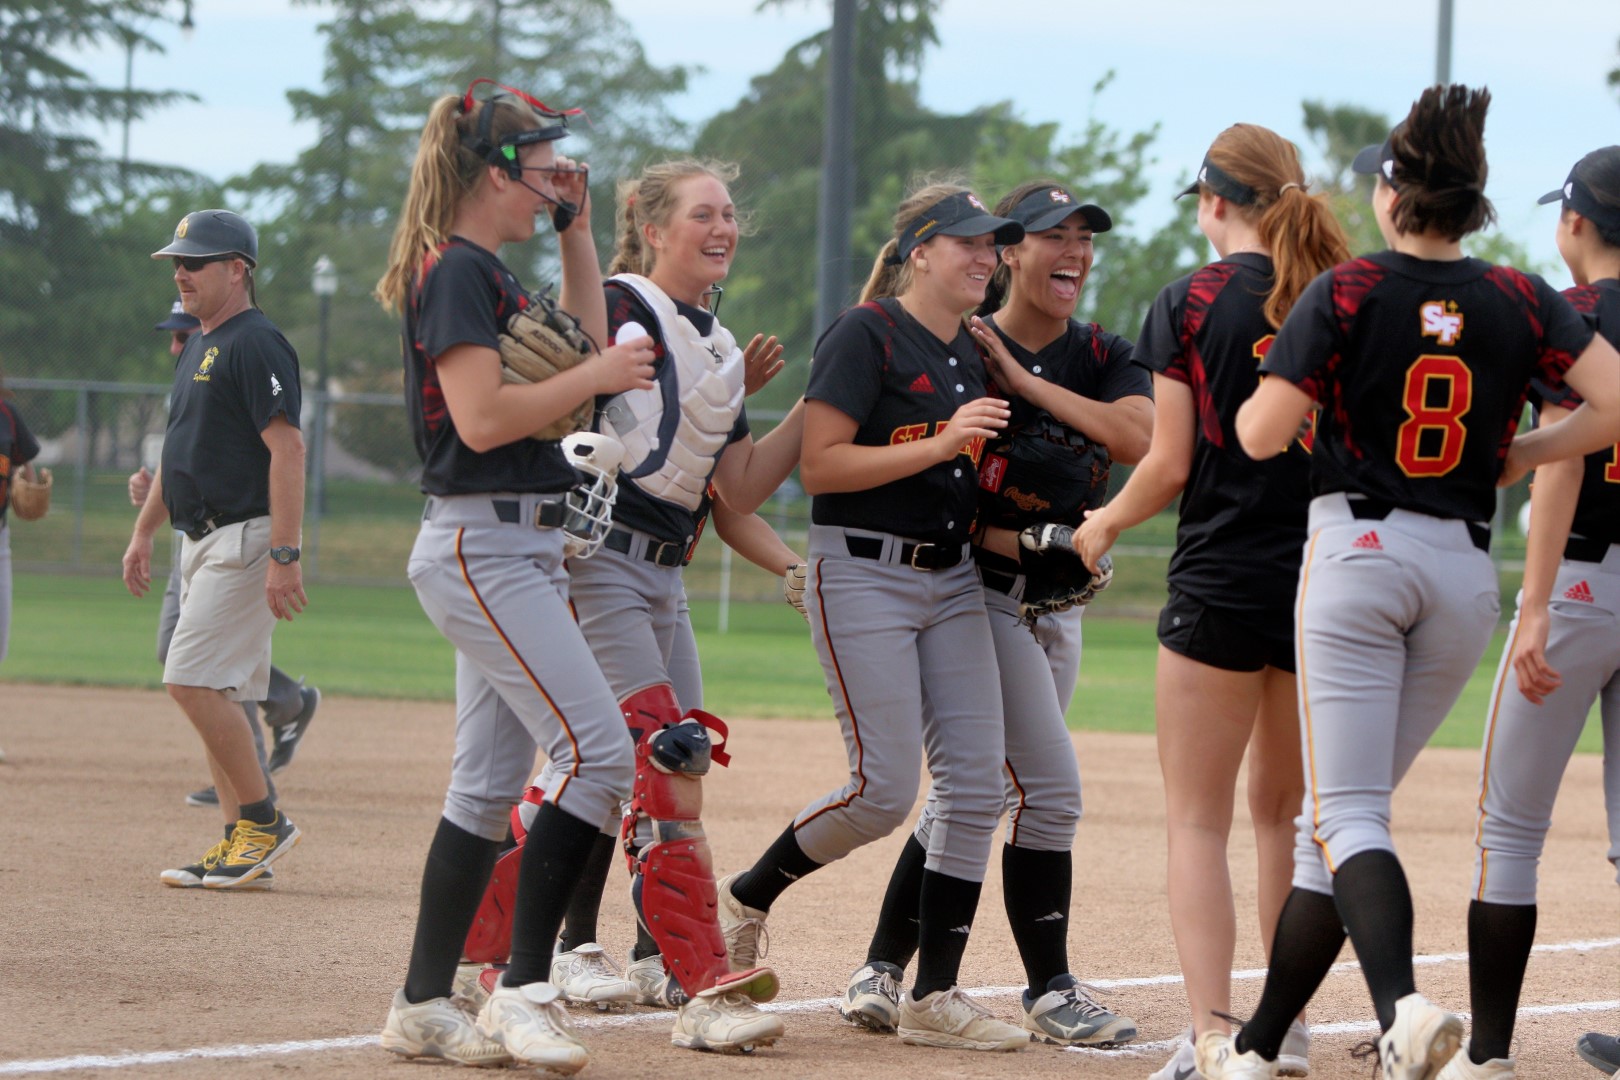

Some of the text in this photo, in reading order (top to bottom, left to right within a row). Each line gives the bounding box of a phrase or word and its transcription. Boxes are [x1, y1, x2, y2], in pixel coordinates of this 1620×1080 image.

[914, 218, 938, 239] SOFTBALL
[1420, 300, 1464, 346] SF
[532, 329, 563, 354] A2000
[1395, 354, 1473, 478] 8
[985, 458, 1000, 487] Rawlings
[1003, 486, 1051, 512] Rawlings
